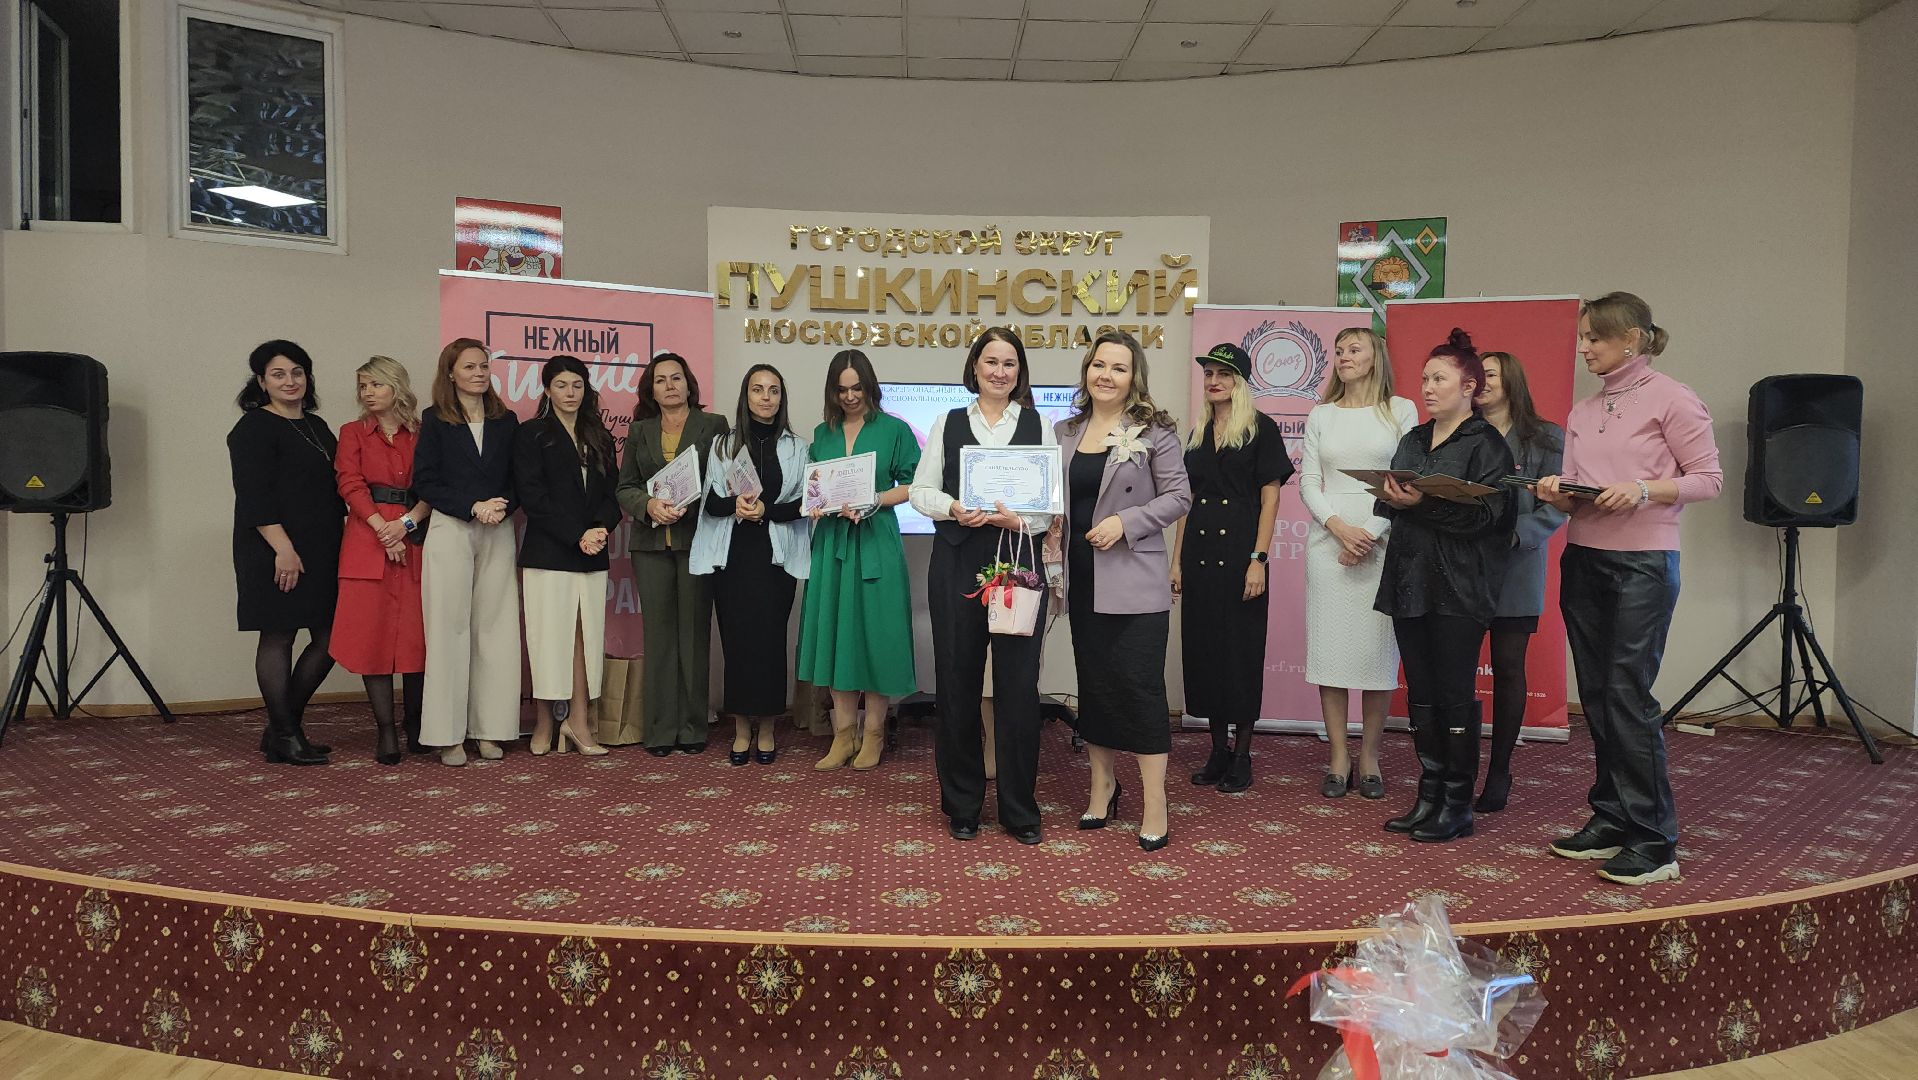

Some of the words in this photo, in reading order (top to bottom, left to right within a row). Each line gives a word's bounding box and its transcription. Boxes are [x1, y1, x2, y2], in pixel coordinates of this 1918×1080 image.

[789, 223, 1002, 258] ГОРОДСКОЙ
[1014, 229, 1124, 256] ОКРУГ
[716, 253, 1199, 315] ПУШКИНСКИЙ
[524, 325, 619, 355] НЕЖНЫЙ
[744, 317, 987, 349] МОСКОВСКОЙ
[1262, 352, 1302, 375] Союз
[1265, 660, 1306, 673] -rf.ru
